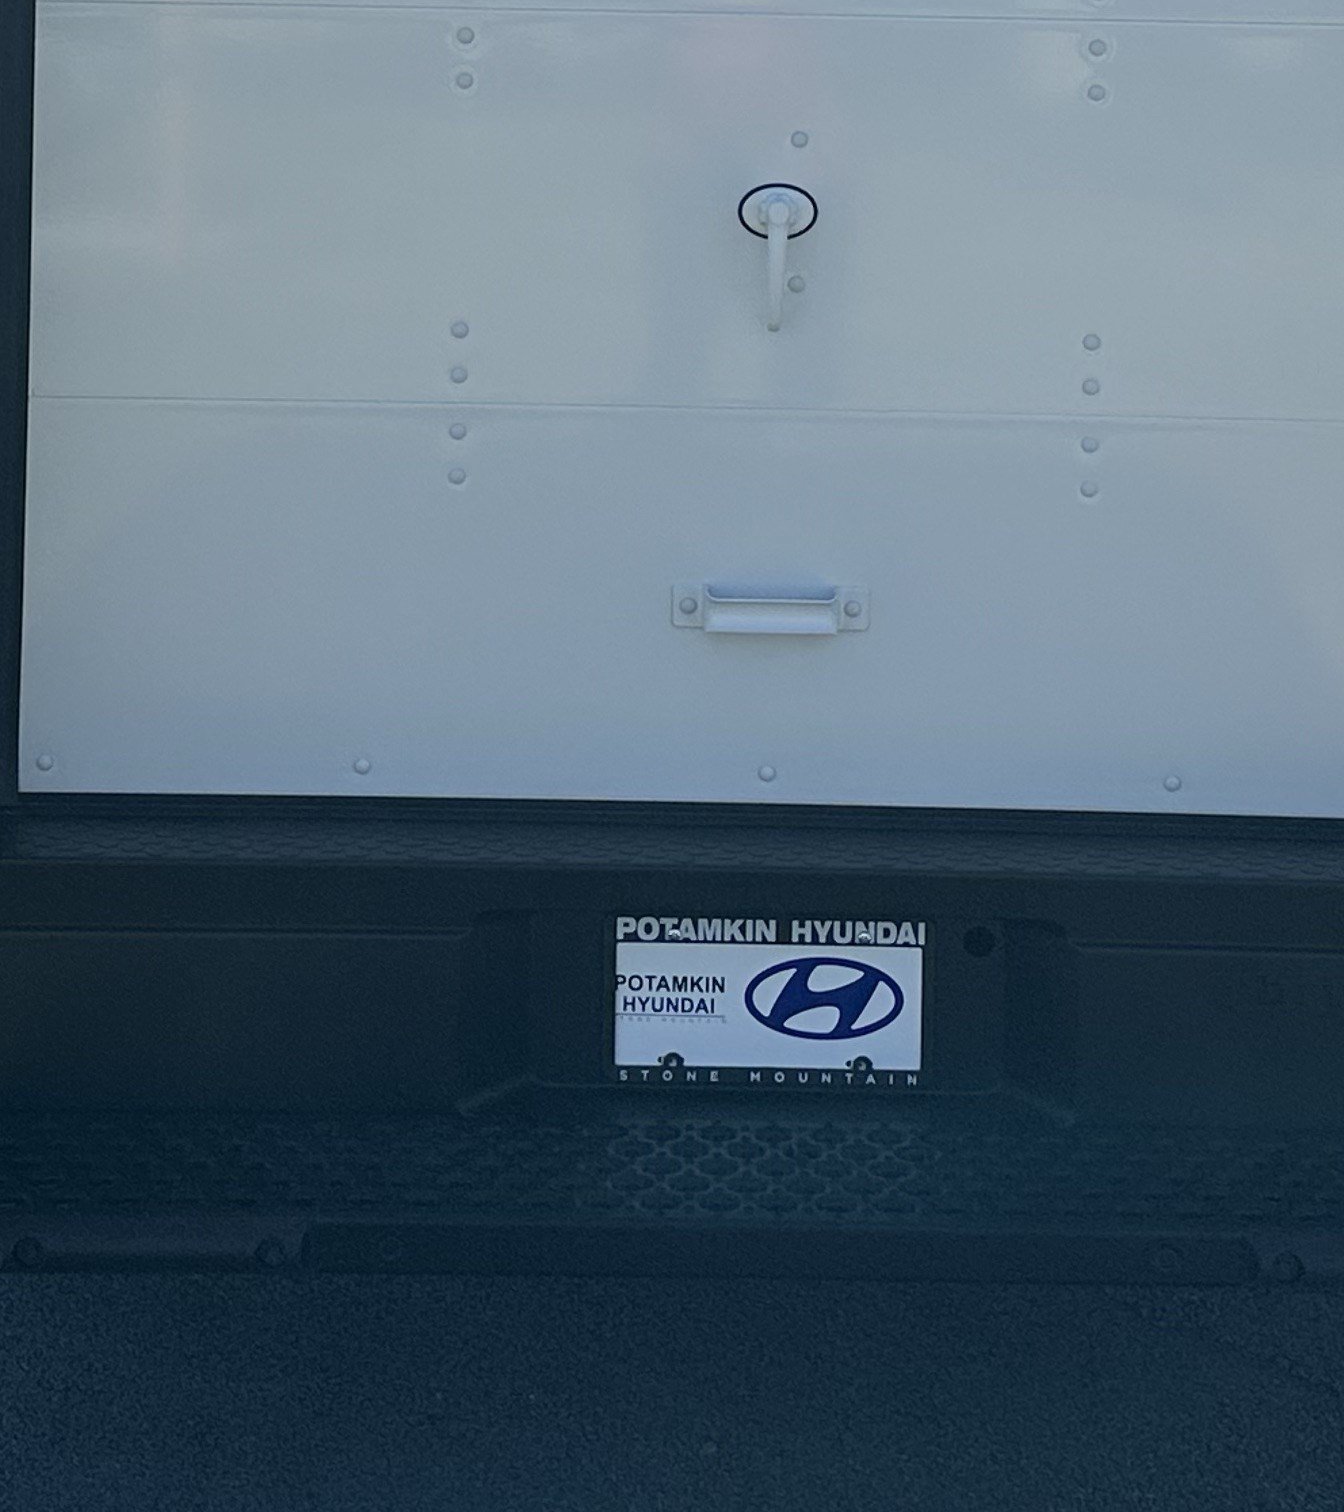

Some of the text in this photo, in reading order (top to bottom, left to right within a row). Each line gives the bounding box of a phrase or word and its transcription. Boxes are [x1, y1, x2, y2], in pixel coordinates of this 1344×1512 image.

[616, 916, 926, 945] POTAMKIN HYUNDAI
[615, 974, 725, 993] POTAMKIN
[622, 996, 715, 1014] HYUNDAI
[619, 1069, 917, 1085] STONE MOUNTAIN
